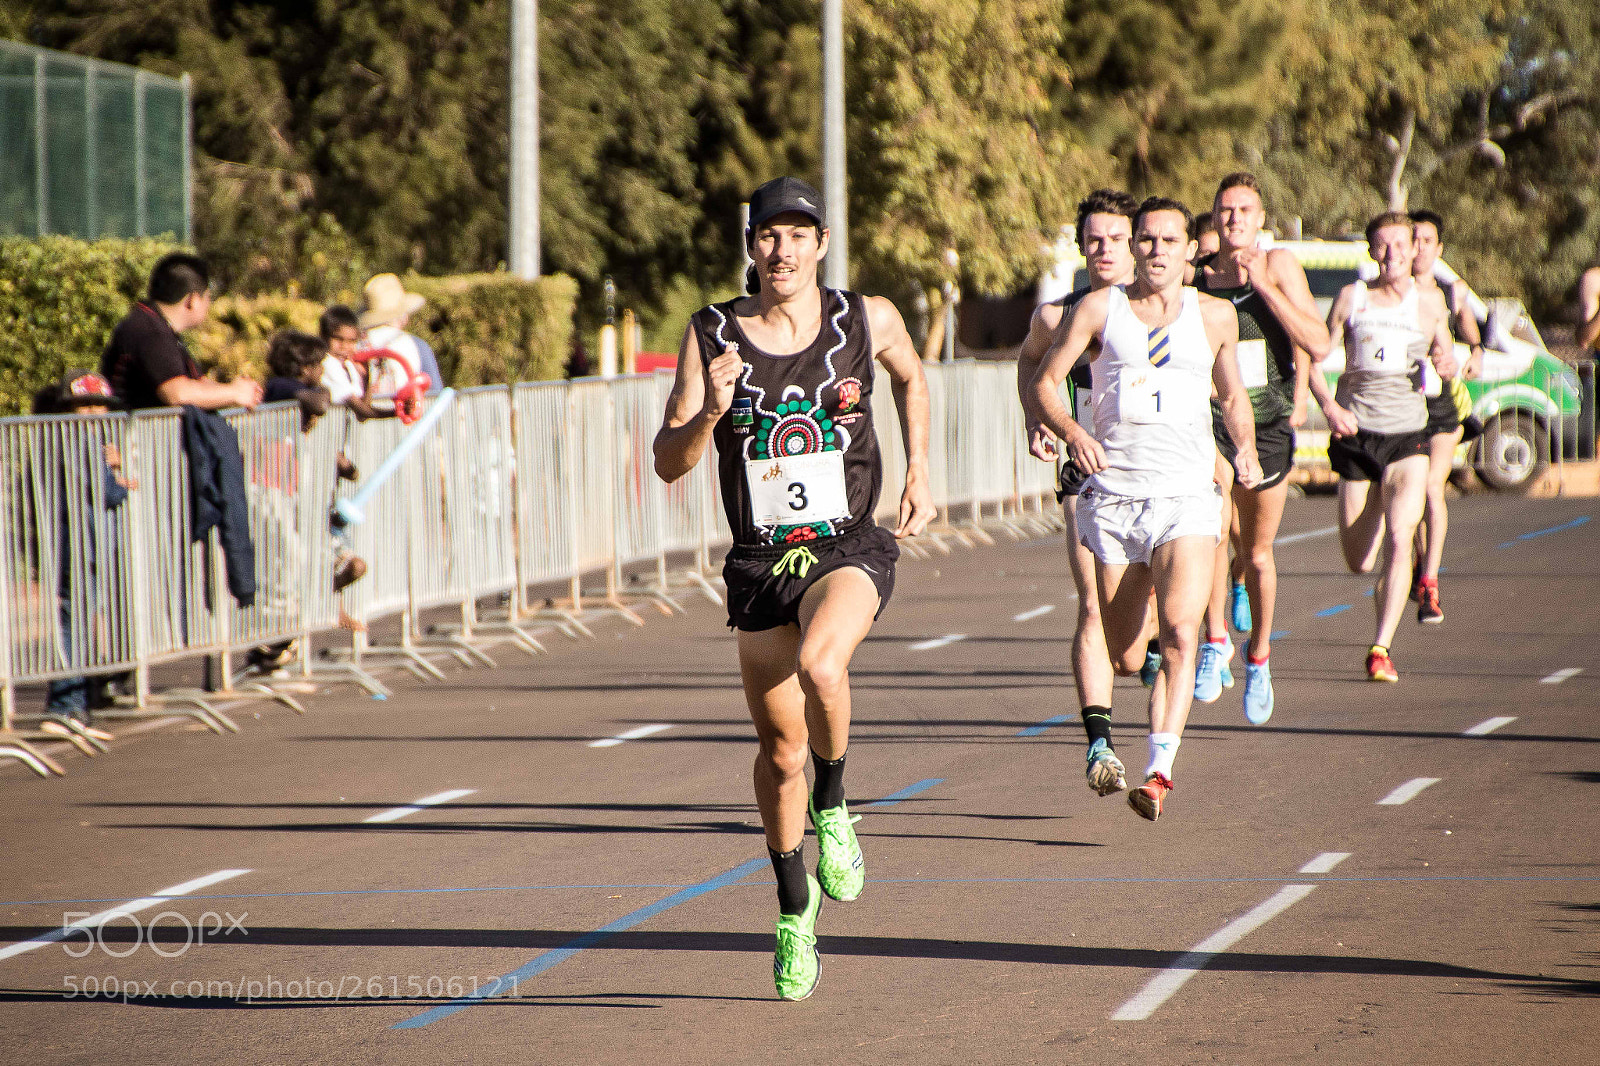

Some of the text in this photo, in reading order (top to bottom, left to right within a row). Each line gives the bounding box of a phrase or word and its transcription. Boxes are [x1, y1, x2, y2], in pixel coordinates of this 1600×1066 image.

[1374, 347, 1385, 362] 4
[1151, 389, 1162, 413] 1
[787, 482, 808, 511] 3
